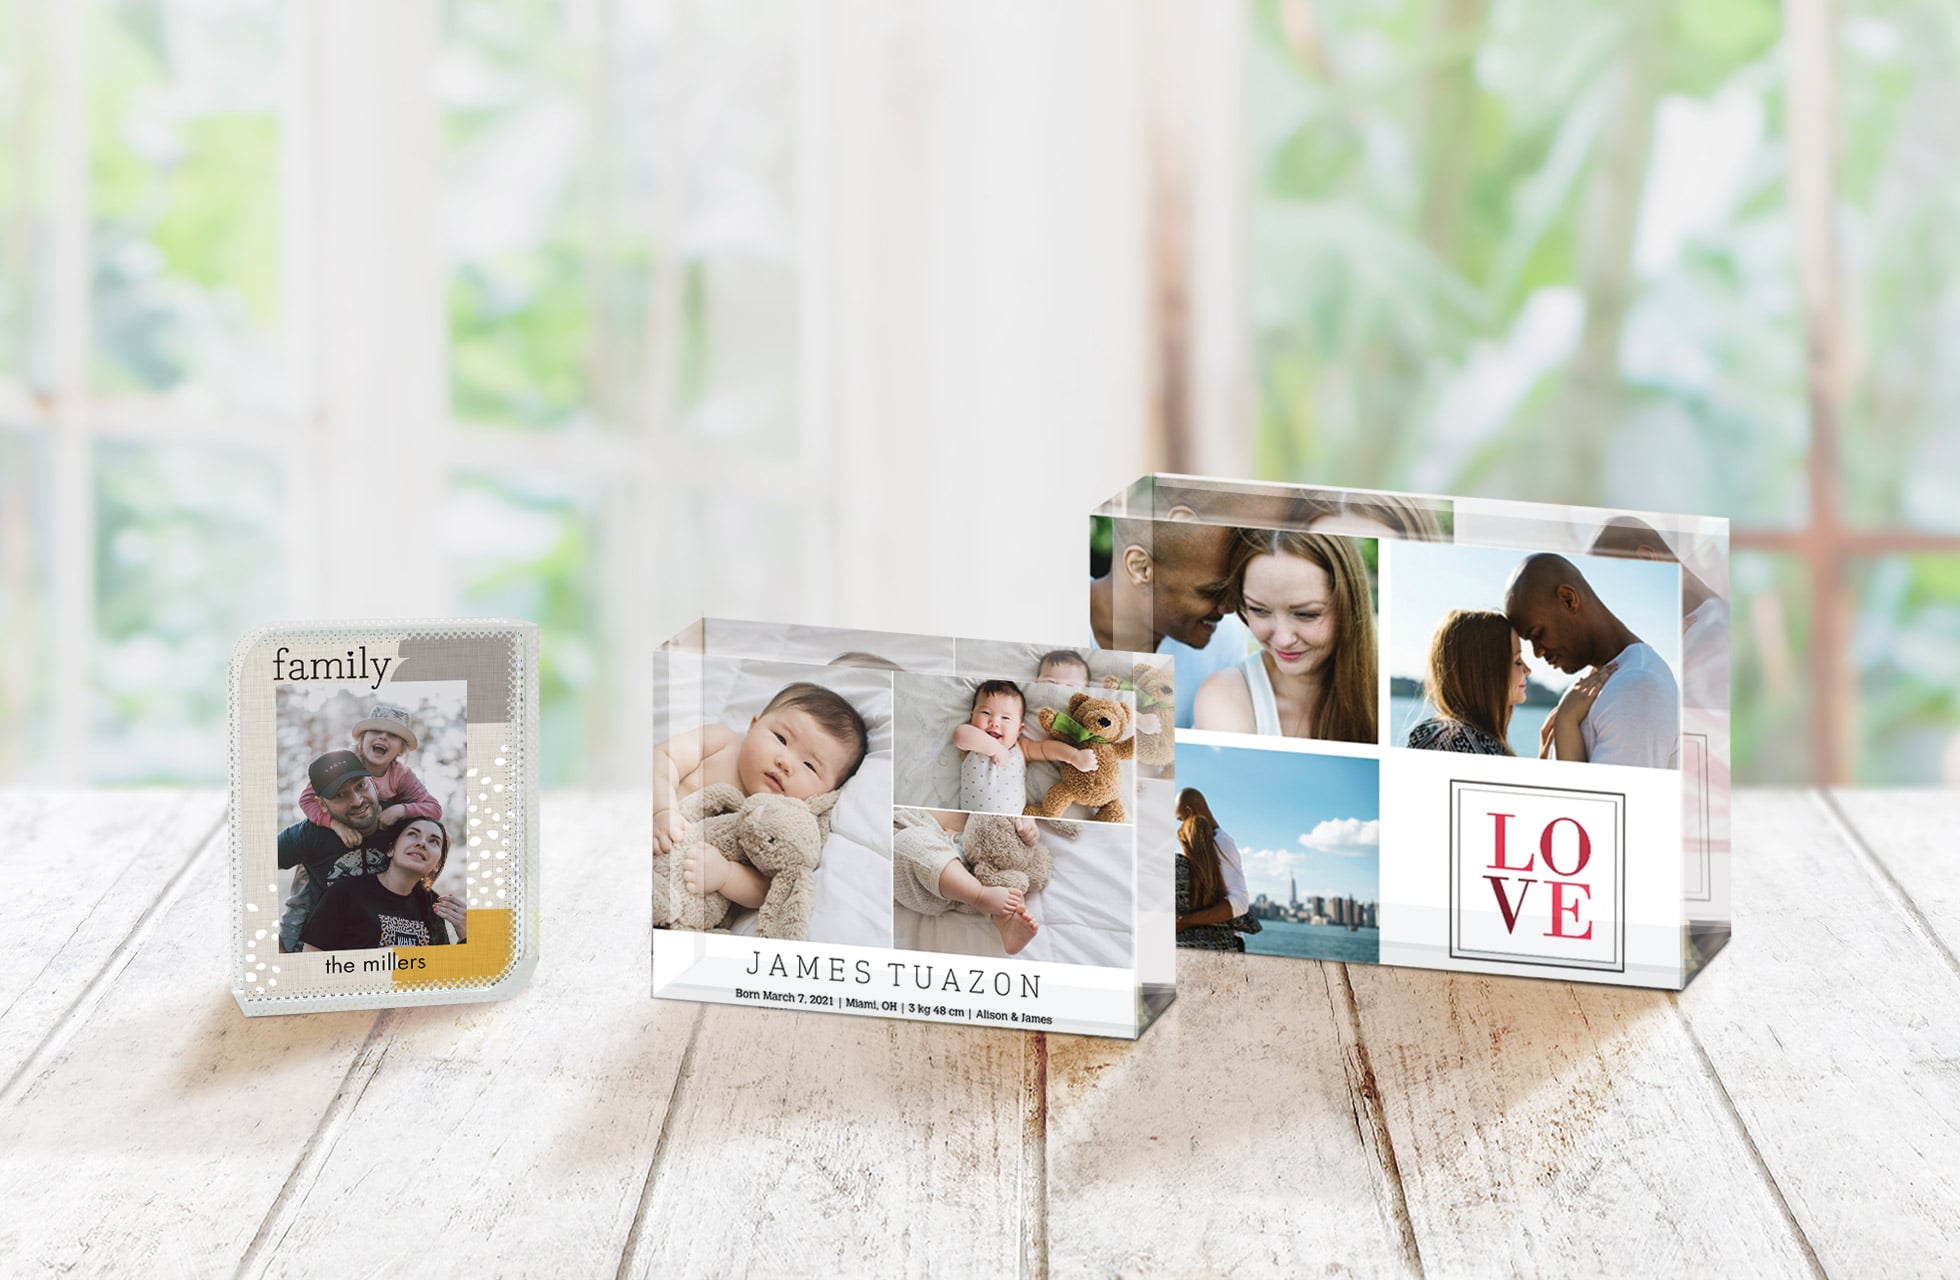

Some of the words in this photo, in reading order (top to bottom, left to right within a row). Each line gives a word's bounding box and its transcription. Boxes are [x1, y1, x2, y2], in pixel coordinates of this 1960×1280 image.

[272, 644, 392, 690] family
[325, 955, 355, 974] the
[363, 952, 426, 972] millers
[746, 950, 871, 985] JAMES
[887, 962, 1041, 999] TUAZON
[735, 988, 760, 1000] Born
[763, 990, 795, 1003] March
[809, 995, 834, 1006] 2021
[881, 1001, 898, 1012] OH
[908, 1003, 916, 1013] 3
[917, 1004, 931, 1016] kg
[933, 1005, 947, 1016] 48
[948, 1008, 965, 1017] cm
[976, 1009, 1008, 1021] Alison
[1011, 1012, 1019, 1022] &
[1021, 1013, 1053, 1025] James
